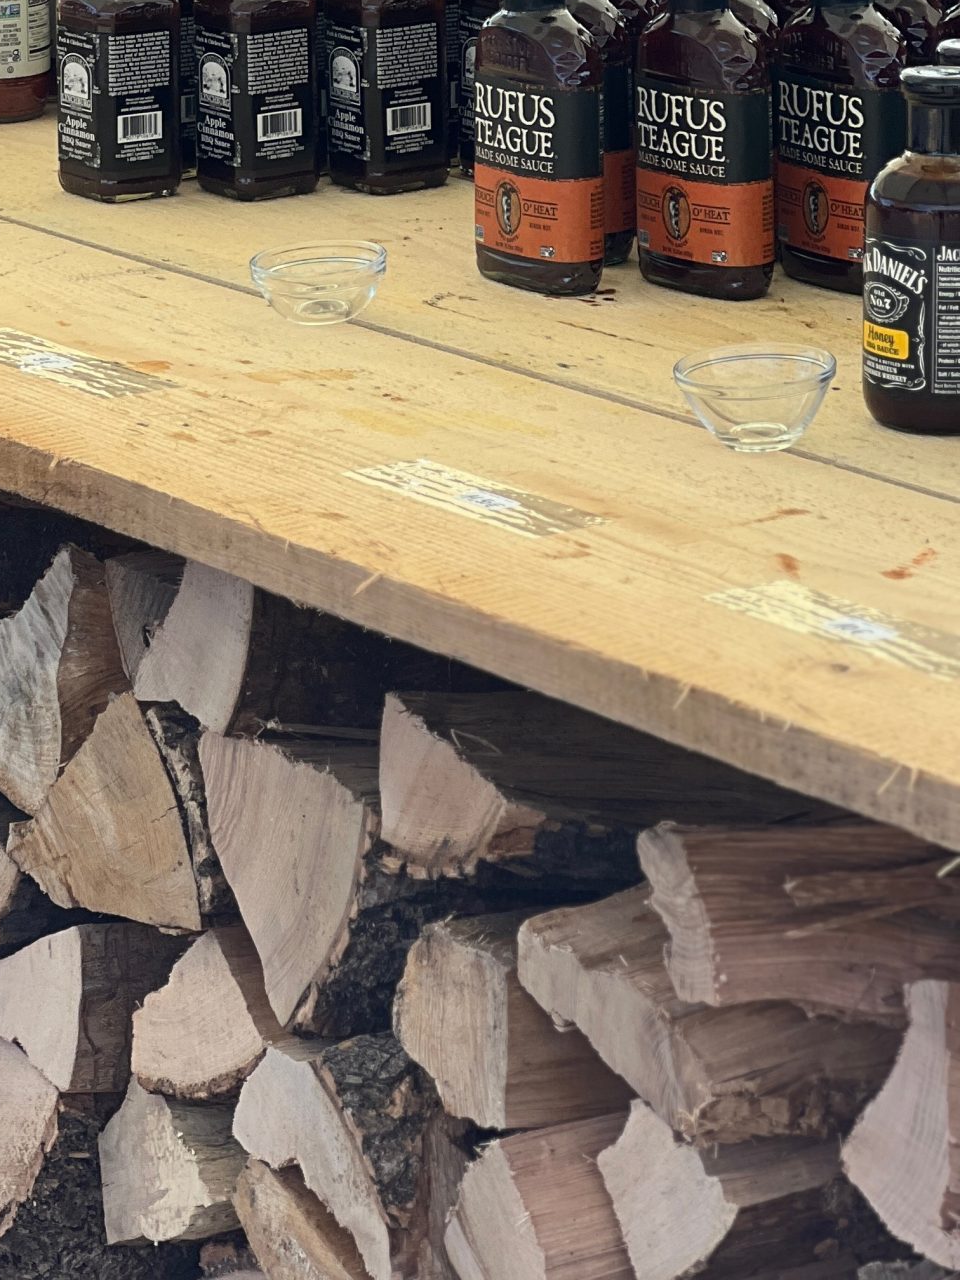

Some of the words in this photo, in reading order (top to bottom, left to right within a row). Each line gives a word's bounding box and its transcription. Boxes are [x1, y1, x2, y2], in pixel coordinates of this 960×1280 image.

[475, 82, 555, 128] RUFUS
[637, 86, 726, 132] RUFUS
[778, 80, 864, 128] RUFUS
[66, 115, 87, 129] Apple
[205, 115, 226, 128] Apple
[335, 108, 356, 122] Apple
[59, 123, 95, 141] Cinnamon
[198, 122, 234, 140] Cinnamon
[328, 115, 364, 134] Cinnamon
[62, 134, 74, 146] BBQ
[75, 139, 91, 149] Sauce
[201, 133, 213, 145] BBQ
[214, 138, 230, 148] Sauce
[332, 128, 343, 140] BBQ
[344, 132, 360, 142] Sauce
[475, 117, 555, 159] TEAGUE
[637, 122, 726, 162] TEAGUE
[779, 116, 863, 159] TEAGUE
[475, 145, 494, 162] MADE
[495, 152, 519, 169] SOME
[520, 157, 554, 174] SAUCE
[639, 151, 660, 167] MADE
[661, 157, 687, 173] SOME
[689, 162, 726, 178] SAUCE
[779, 144, 801, 161] MADE
[802, 152, 827, 167] SOME
[828, 158, 863, 174] SAUCE
[534, 204, 558, 216] HEAT
[704, 209, 730, 220] HEAT
[842, 204, 864, 217] HEAT
[937, 246, 960, 261] JAC
[873, 247, 928, 294] DANIEL'S
[868, 325, 894, 347] Honey
[877, 344, 899, 355] SAUCE
